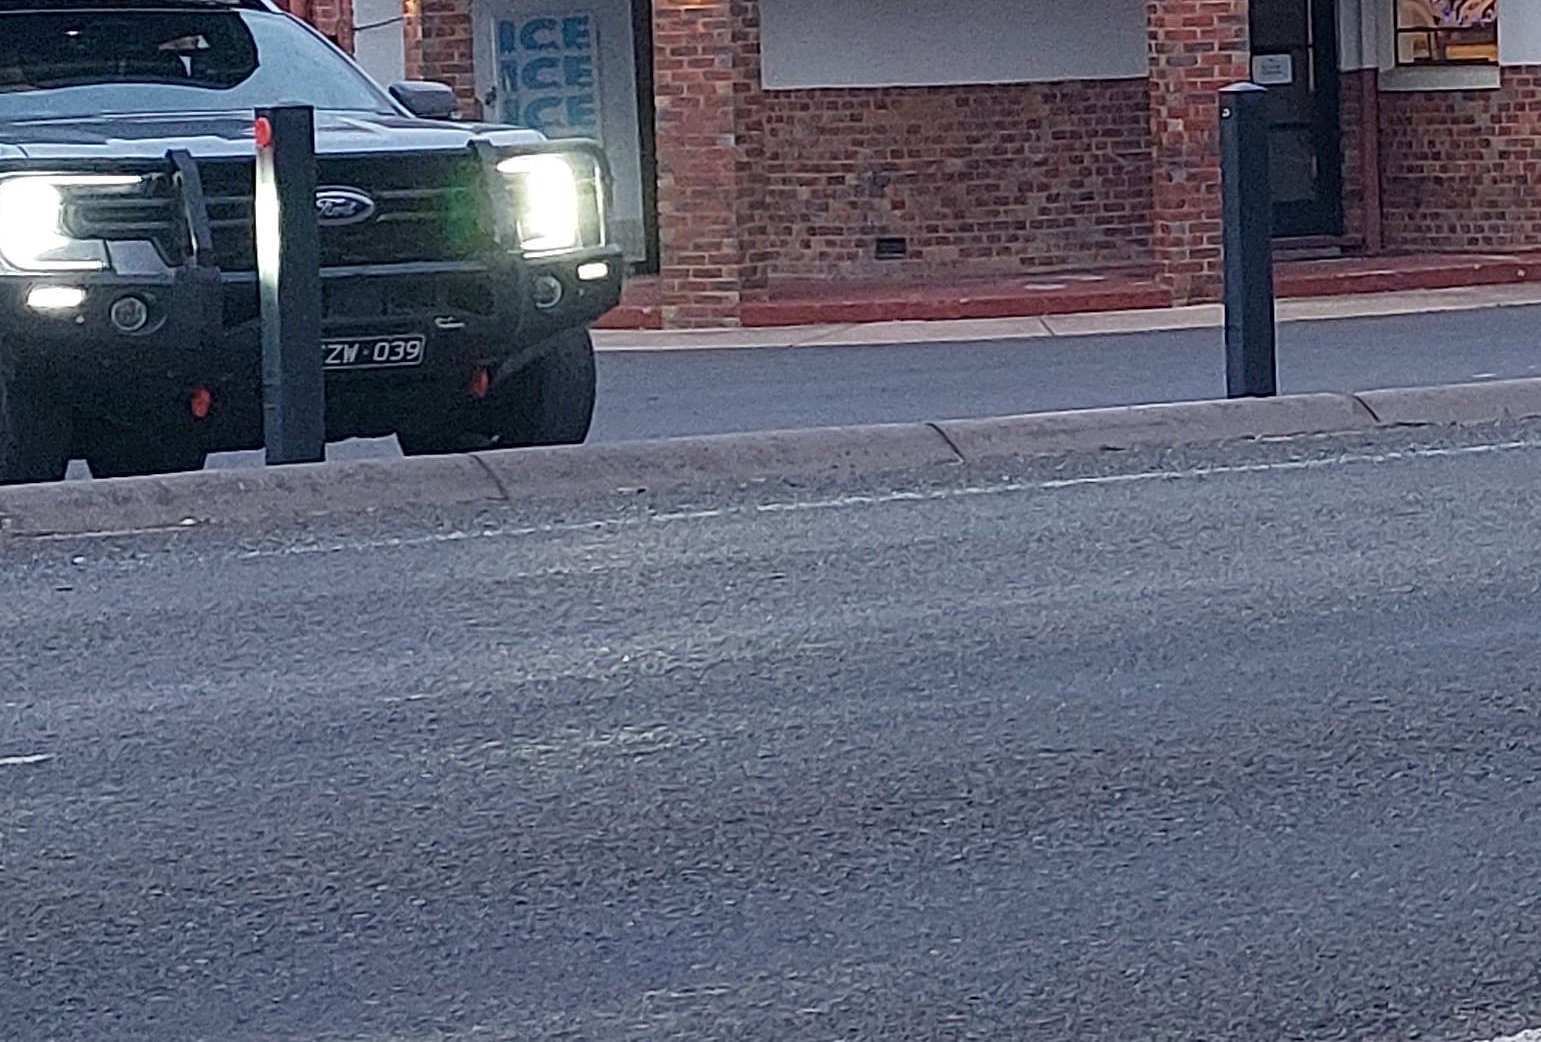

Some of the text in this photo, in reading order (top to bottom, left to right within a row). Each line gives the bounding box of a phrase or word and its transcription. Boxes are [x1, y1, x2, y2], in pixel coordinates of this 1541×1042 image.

[499, 16, 591, 54] ICE
[502, 56, 593, 92] ICE
[504, 94, 597, 128] ICE
